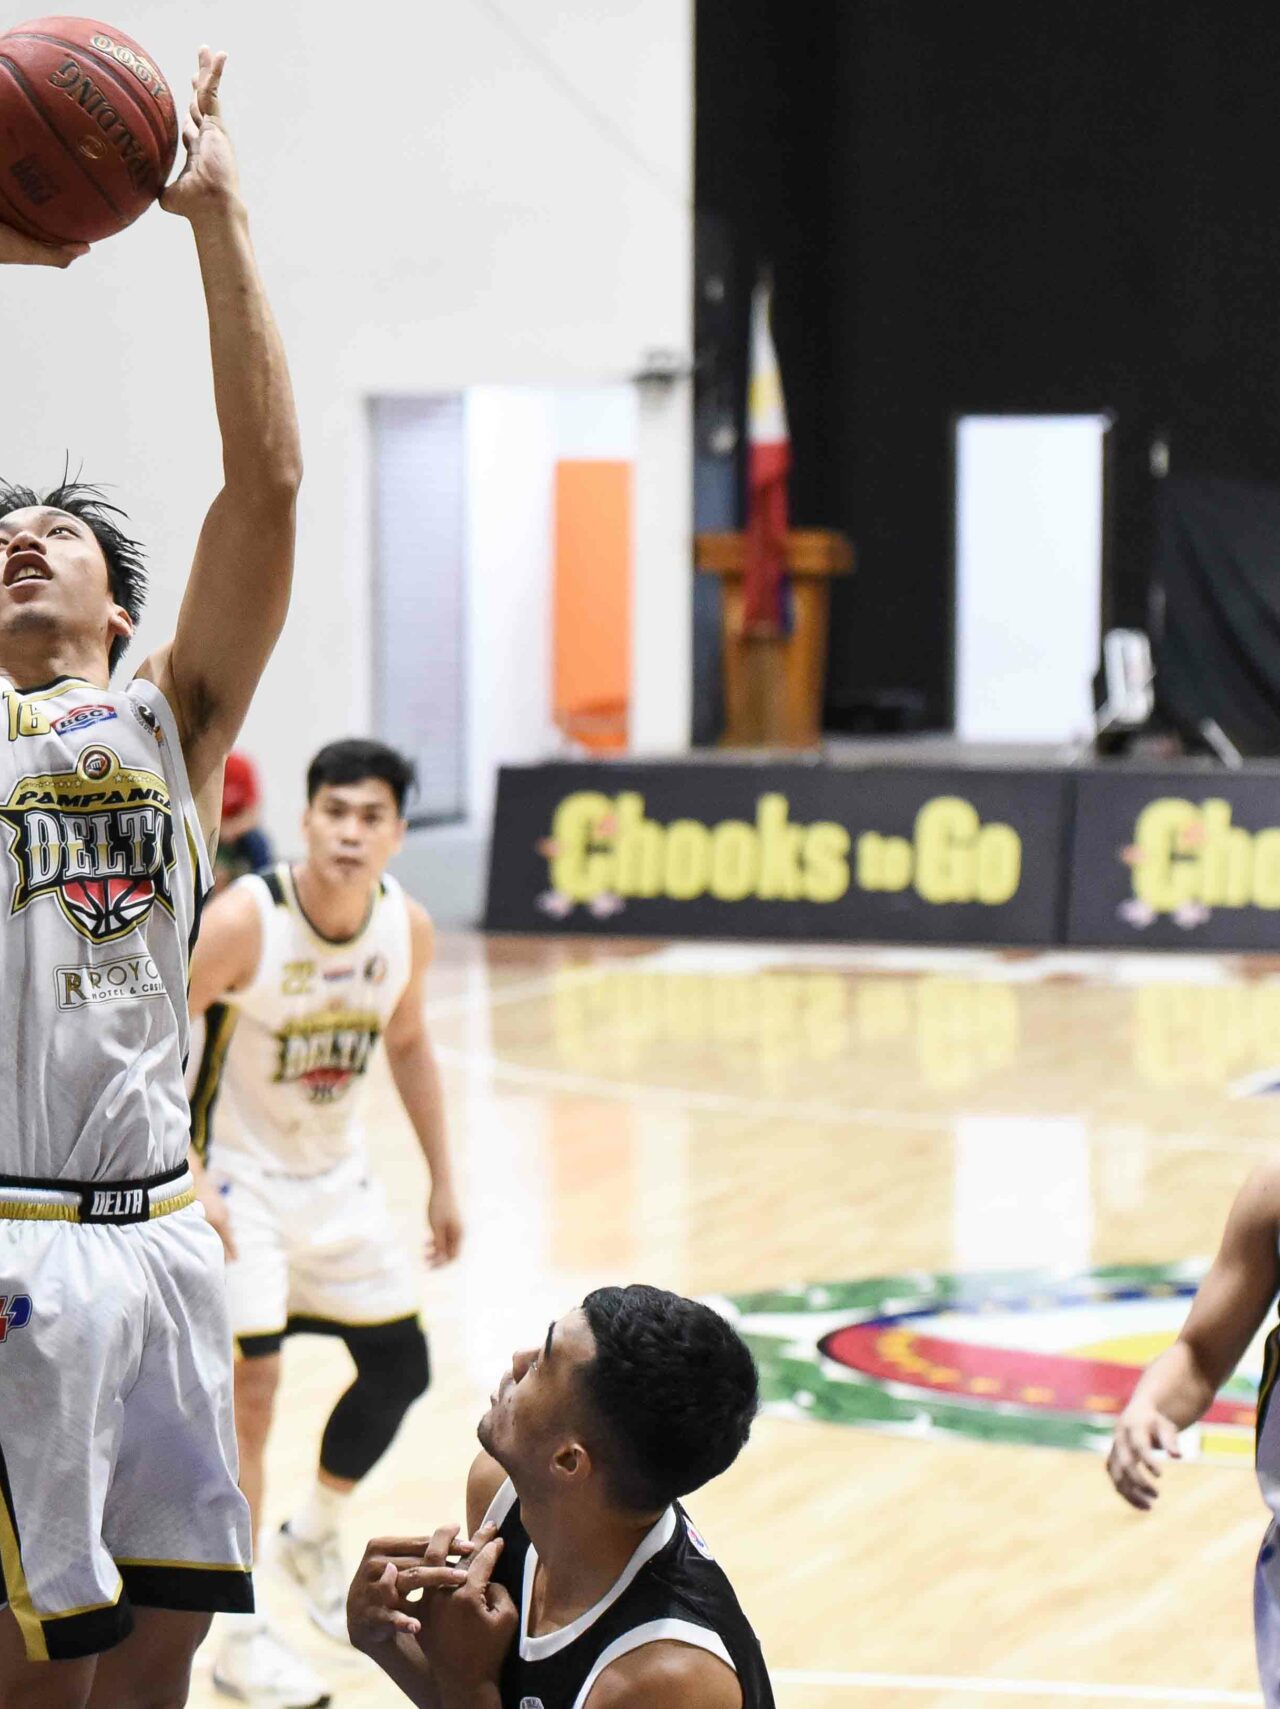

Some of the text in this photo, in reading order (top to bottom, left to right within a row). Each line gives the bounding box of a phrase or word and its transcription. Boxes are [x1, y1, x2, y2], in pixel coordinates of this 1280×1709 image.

[48, 56, 160, 196] SPALDING
[3, 691, 51, 741] 16
[59, 708, 105, 730] BGC
[551, 790, 1022, 906] Chooks to Go
[91, 989, 125, 999] HOTEL
[90, 1189, 143, 1216] DELTA
